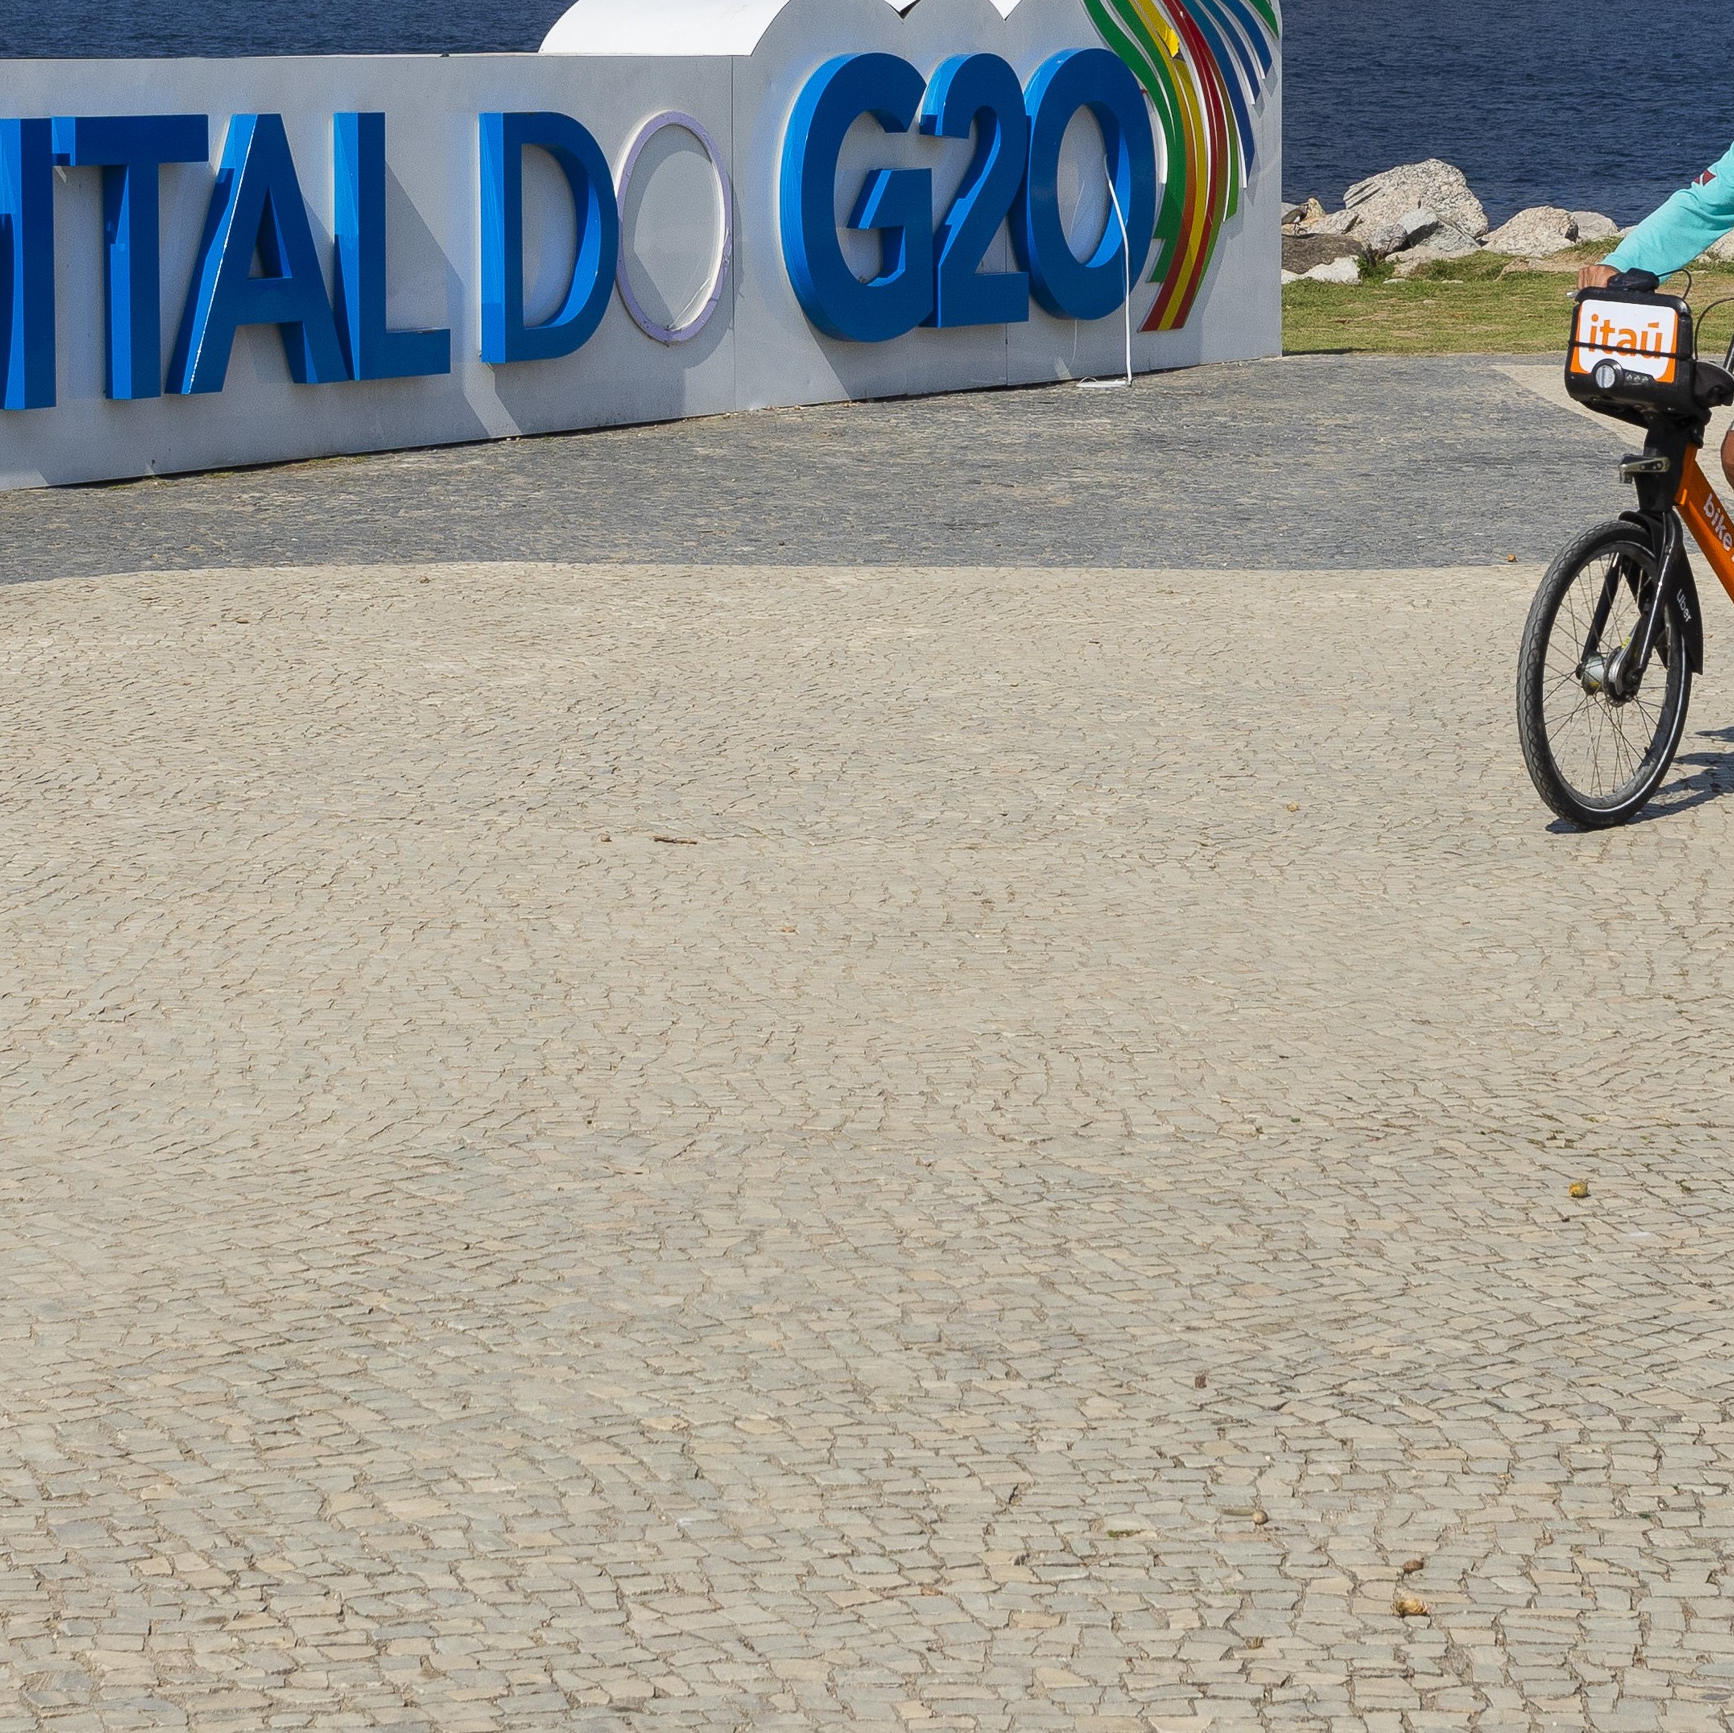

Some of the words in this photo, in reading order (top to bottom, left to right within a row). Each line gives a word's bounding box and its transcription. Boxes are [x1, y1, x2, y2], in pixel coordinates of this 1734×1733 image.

[479, 110, 732, 364] DO
[779, 48, 1158, 343] G20
[1588, 313, 1663, 359] itaú
[1703, 493, 1733, 552] bike
[1676, 588, 1692, 623] Uber
